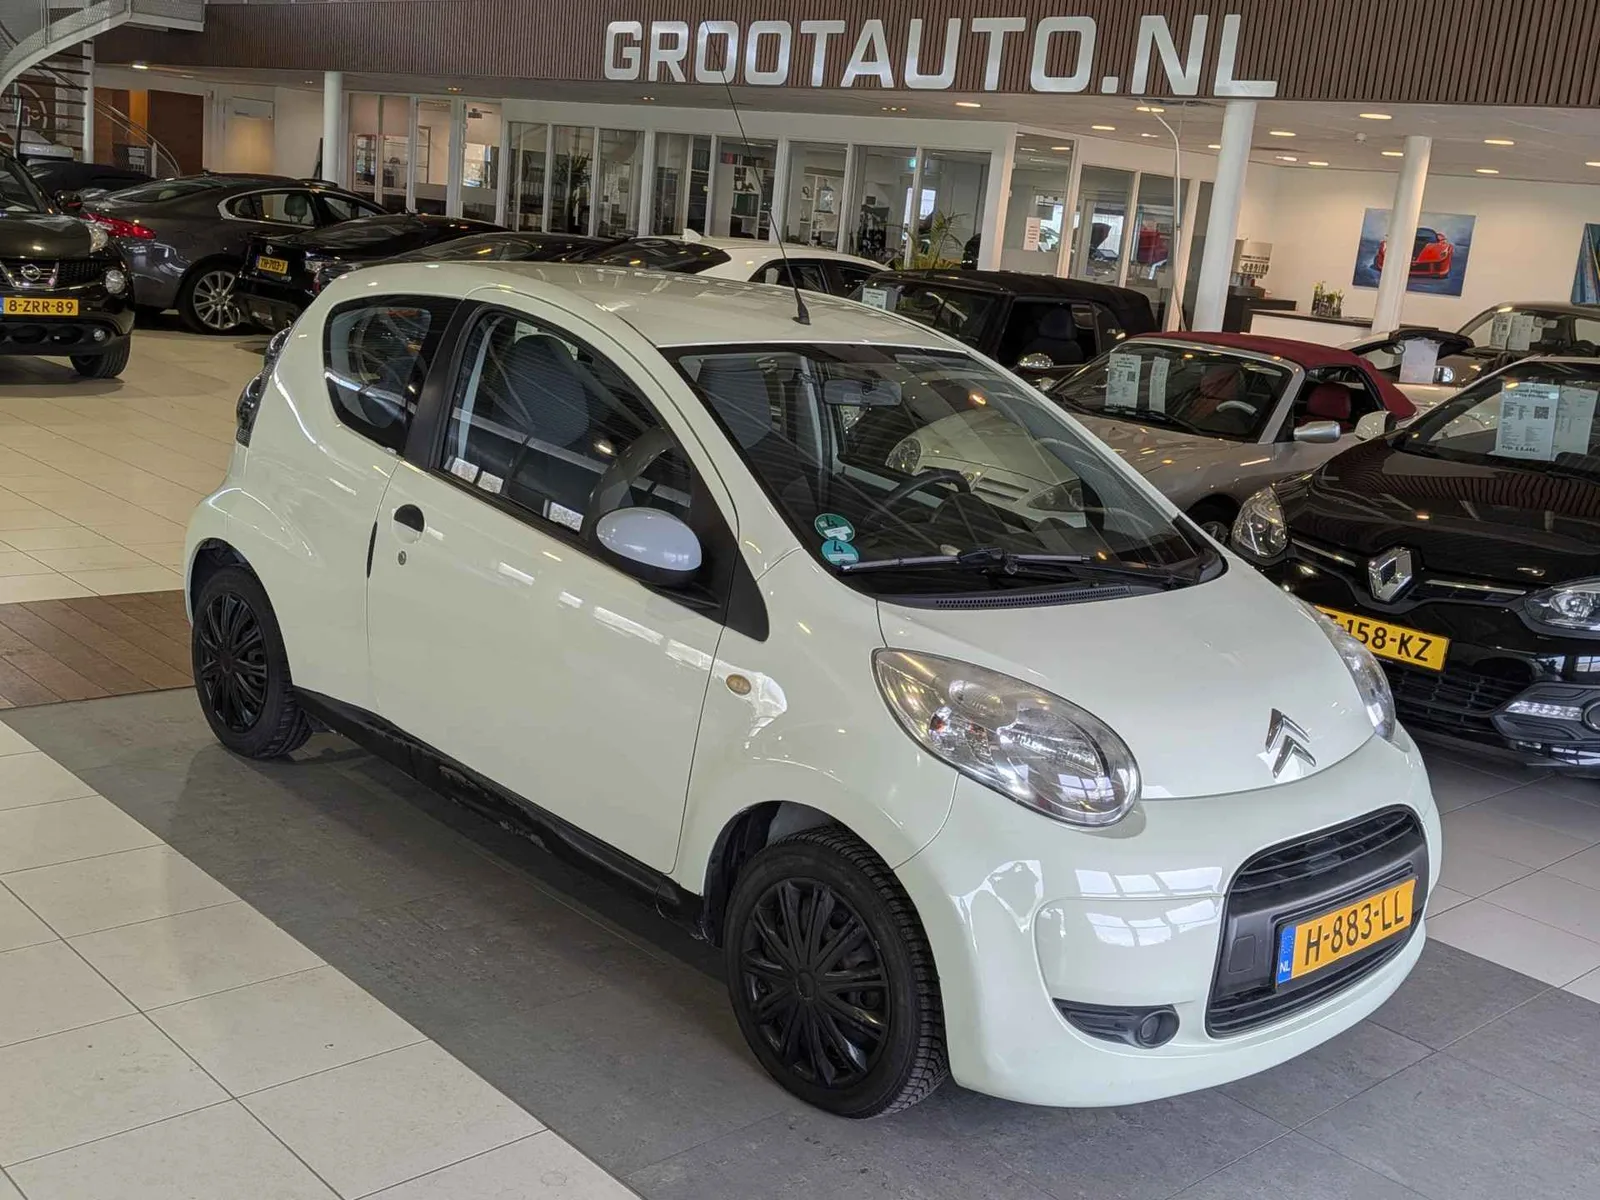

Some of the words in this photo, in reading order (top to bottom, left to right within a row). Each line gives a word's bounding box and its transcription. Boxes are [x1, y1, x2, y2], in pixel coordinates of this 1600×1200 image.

[604, 14, 1277, 97] GROOTAUTO.NL
[9, 300, 74, 313] 8-ZRR-89
[833, 540, 844, 553] 4
[1322, 613, 1433, 662] -158-KZ
[1305, 890, 1405, 966] H-883-LL
[1279, 961, 1291, 974] NL
